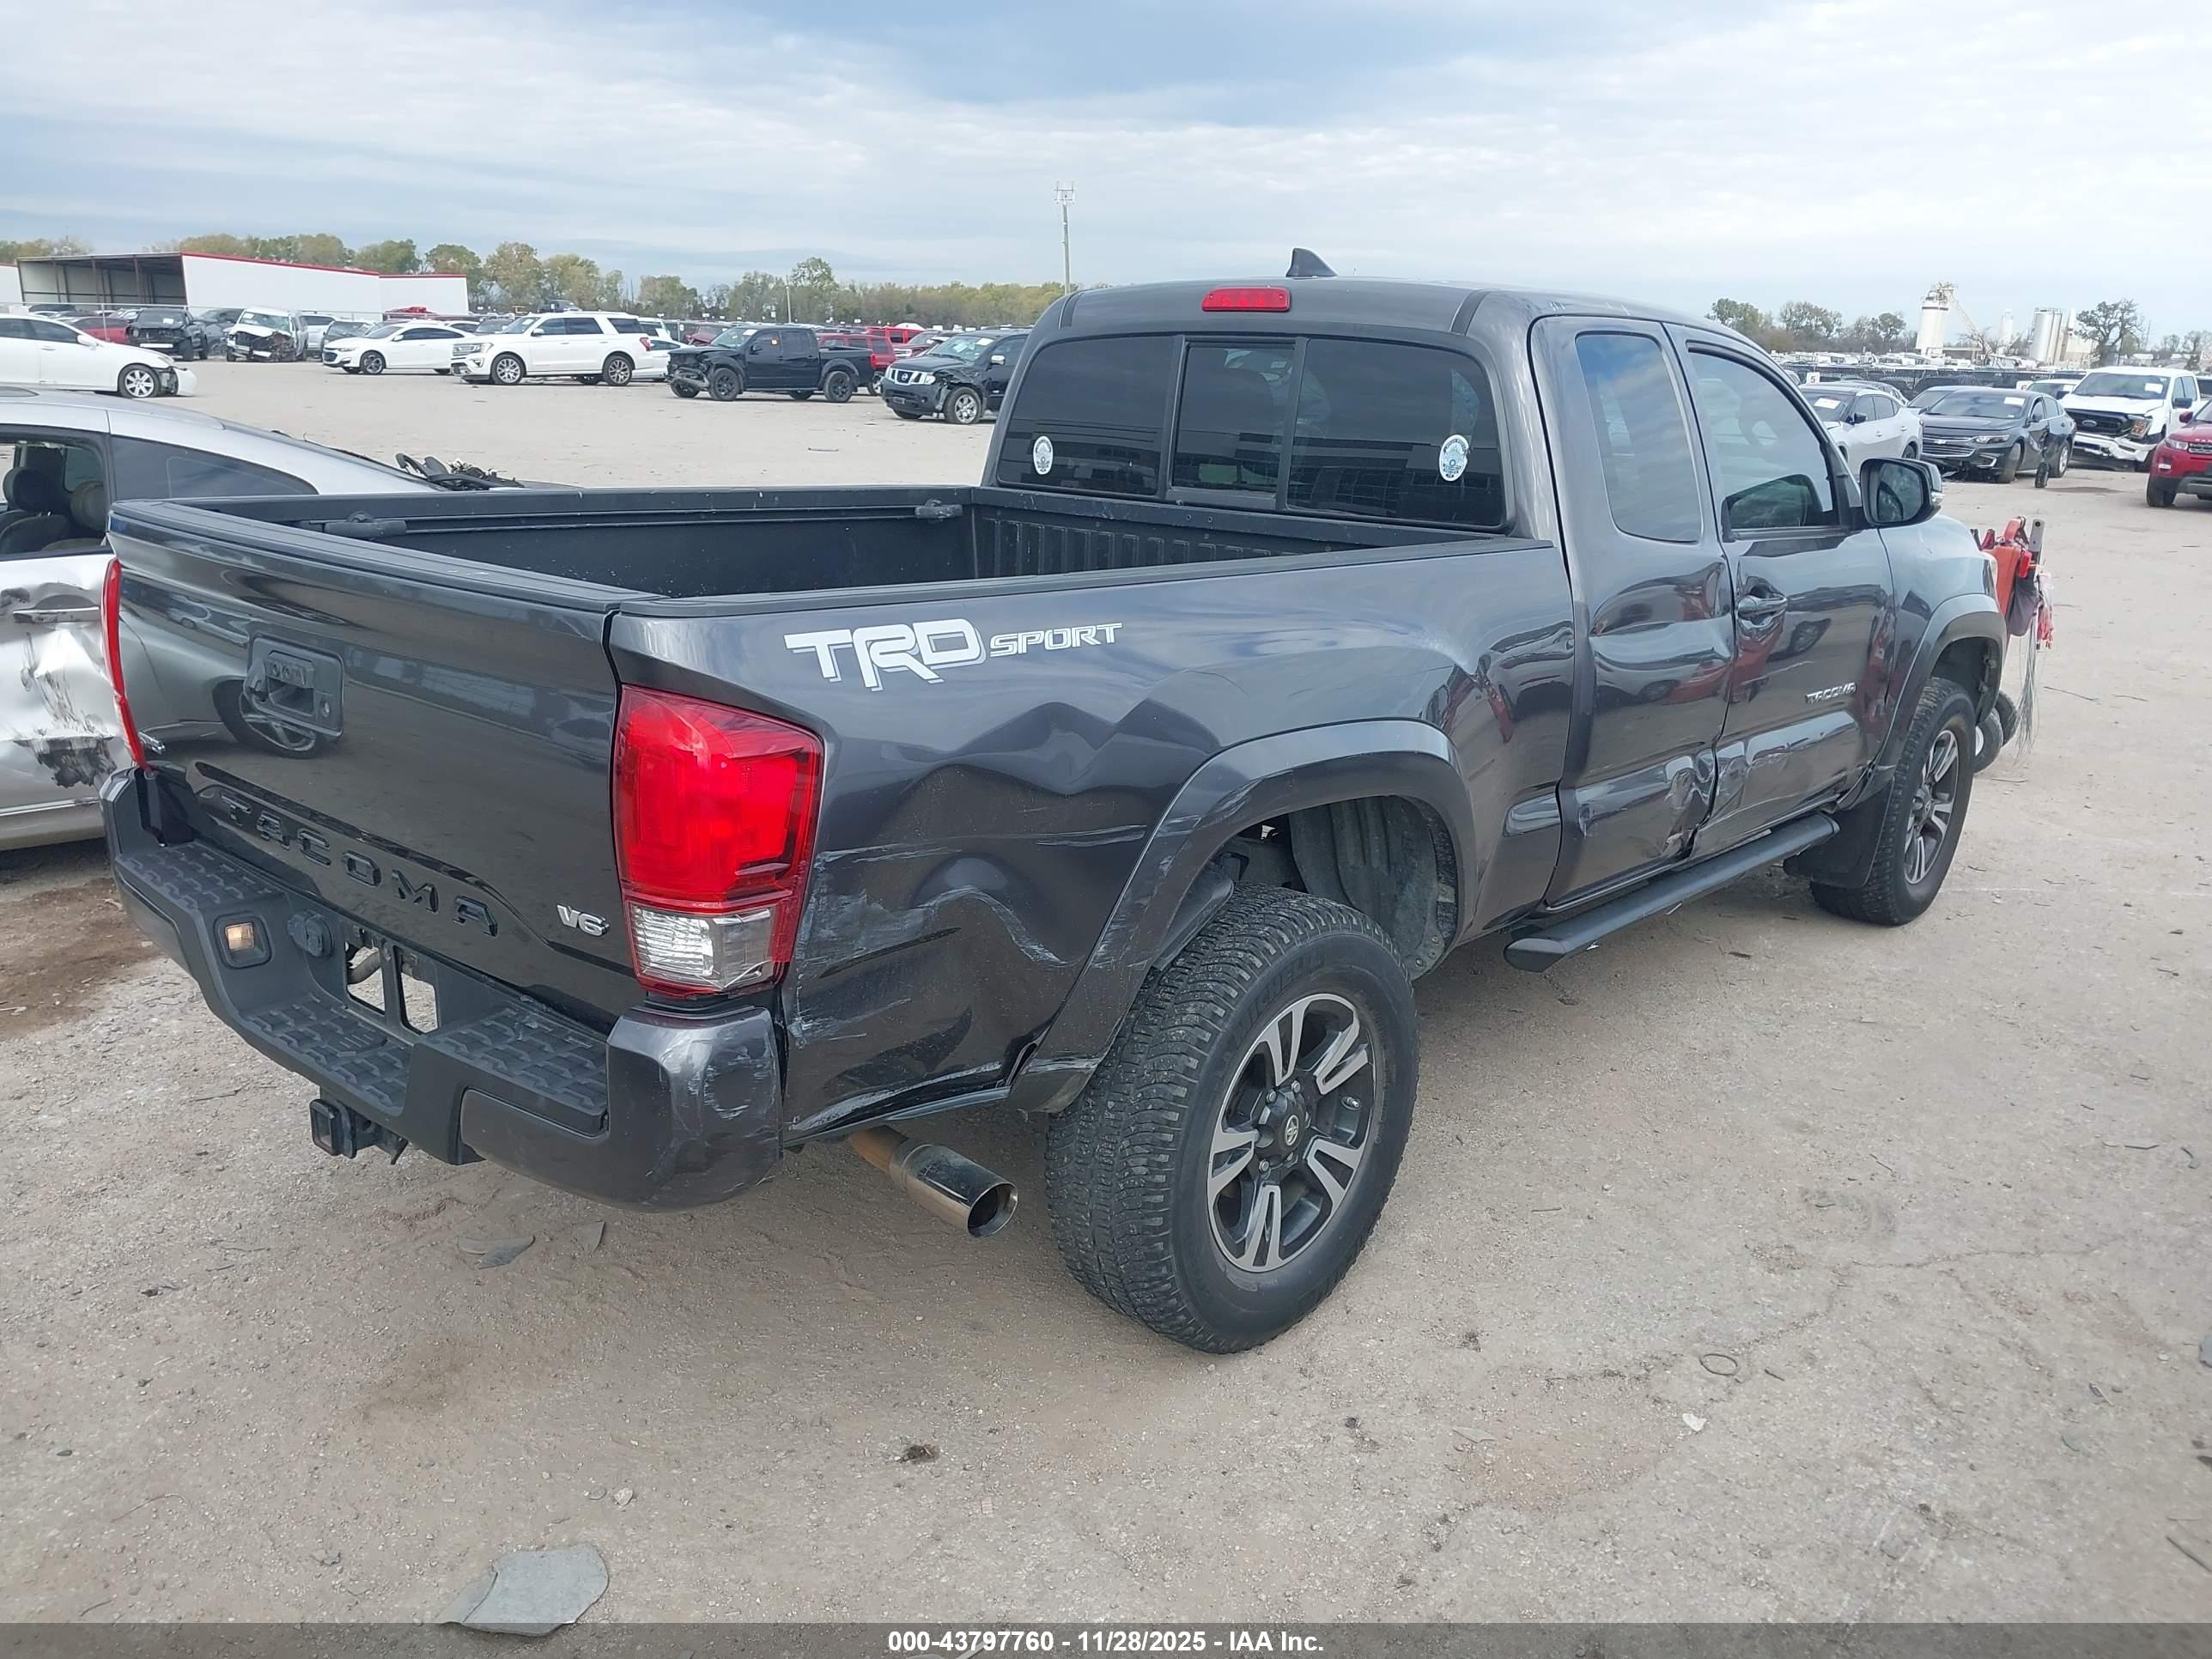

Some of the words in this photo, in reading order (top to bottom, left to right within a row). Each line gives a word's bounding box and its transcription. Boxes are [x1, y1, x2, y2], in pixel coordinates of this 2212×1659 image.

[783, 617, 988, 693] TRD
[989, 622, 1124, 658] SPORT
[1805, 682, 1856, 704] TACOMA
[220, 791, 499, 938] TACOMA
[556, 904, 611, 938] V6
